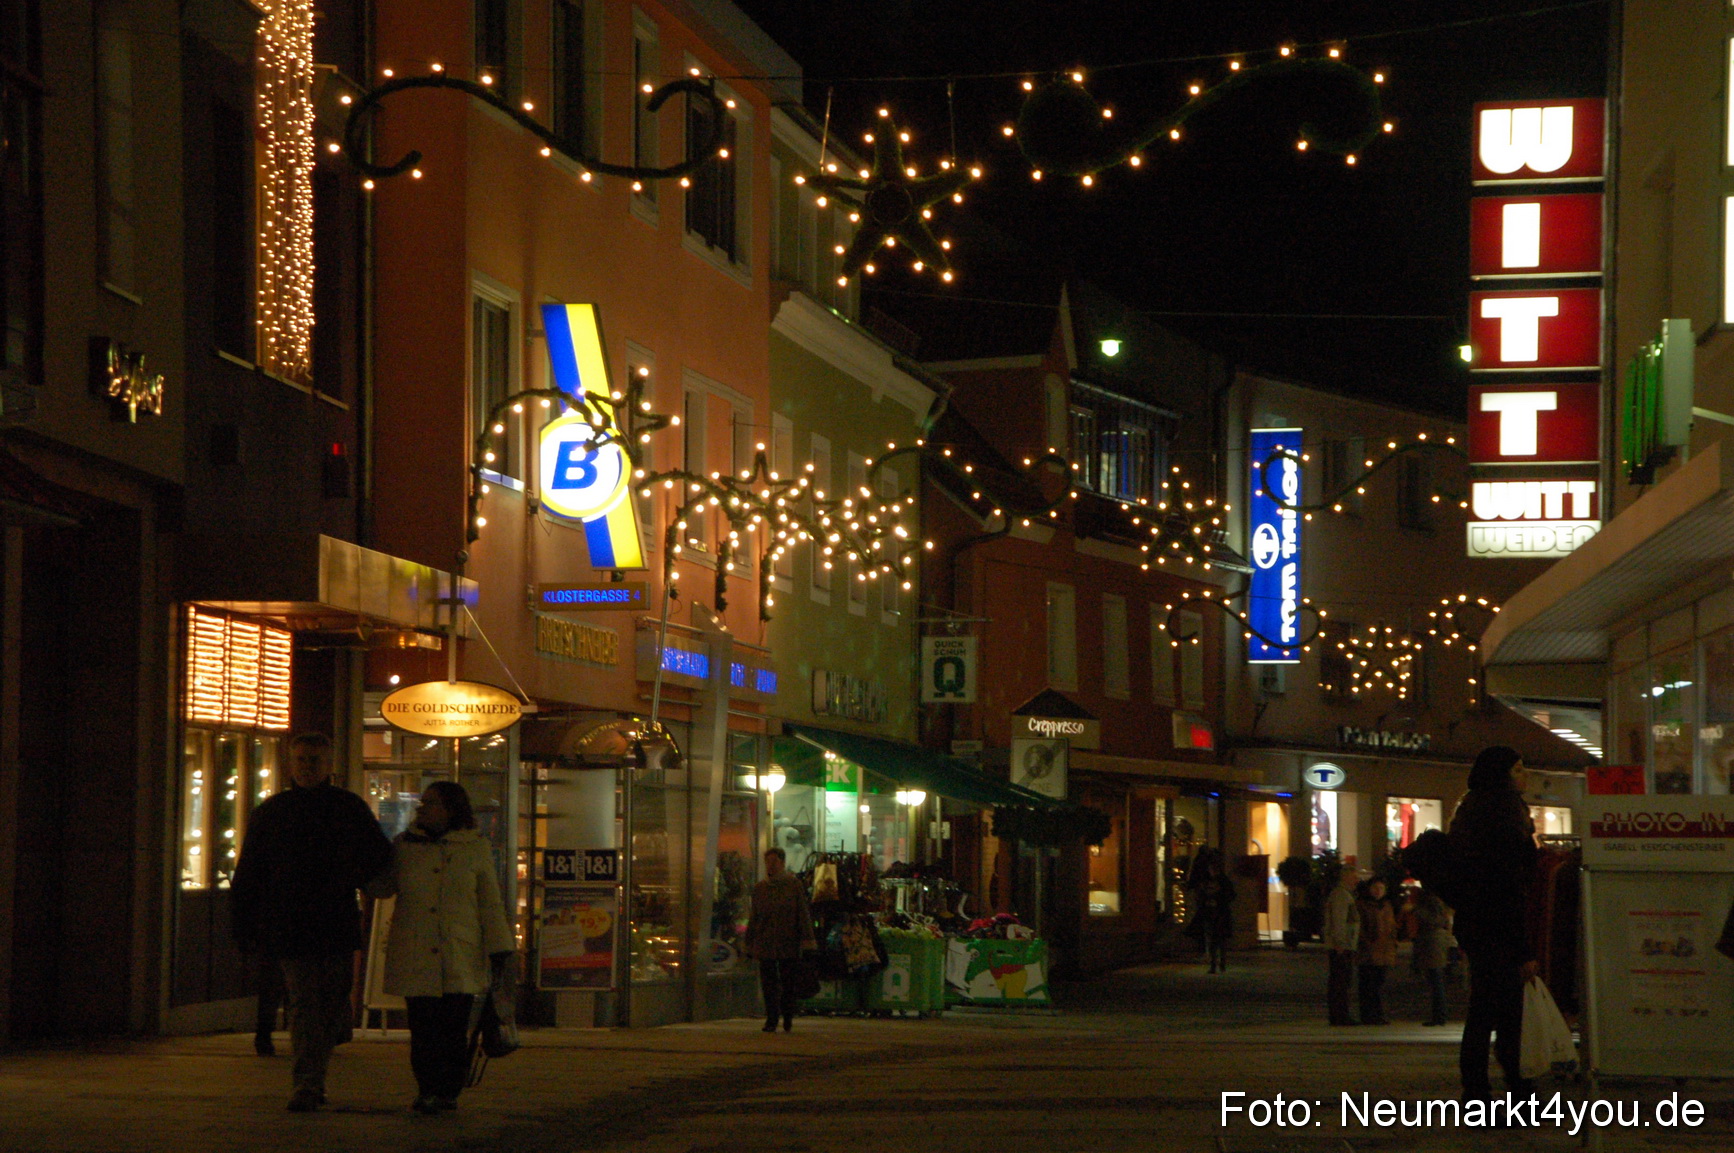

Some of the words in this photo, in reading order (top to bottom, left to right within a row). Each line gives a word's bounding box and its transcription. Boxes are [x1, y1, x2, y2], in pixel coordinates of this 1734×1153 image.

[1479, 105, 1574, 456] WITT
[551, 440, 600, 490] B
[1472, 480, 1596, 520] WITT
[542, 588, 631, 603] KLOSTERGASSE
[633, 590, 641, 602] 4
[1280, 562, 1298, 643] TOM
[933, 656, 965, 698] Q
[387, 703, 410, 713] DIE
[413, 702, 517, 715] GOLDSCHMIEDE
[1028, 717, 1084, 738] Creppresso
[1603, 812, 1685, 832] PHOTO
[1702, 812, 1725, 832] IN
[547, 855, 576, 874] 1&1
[584, 855, 615, 875] 1&1
